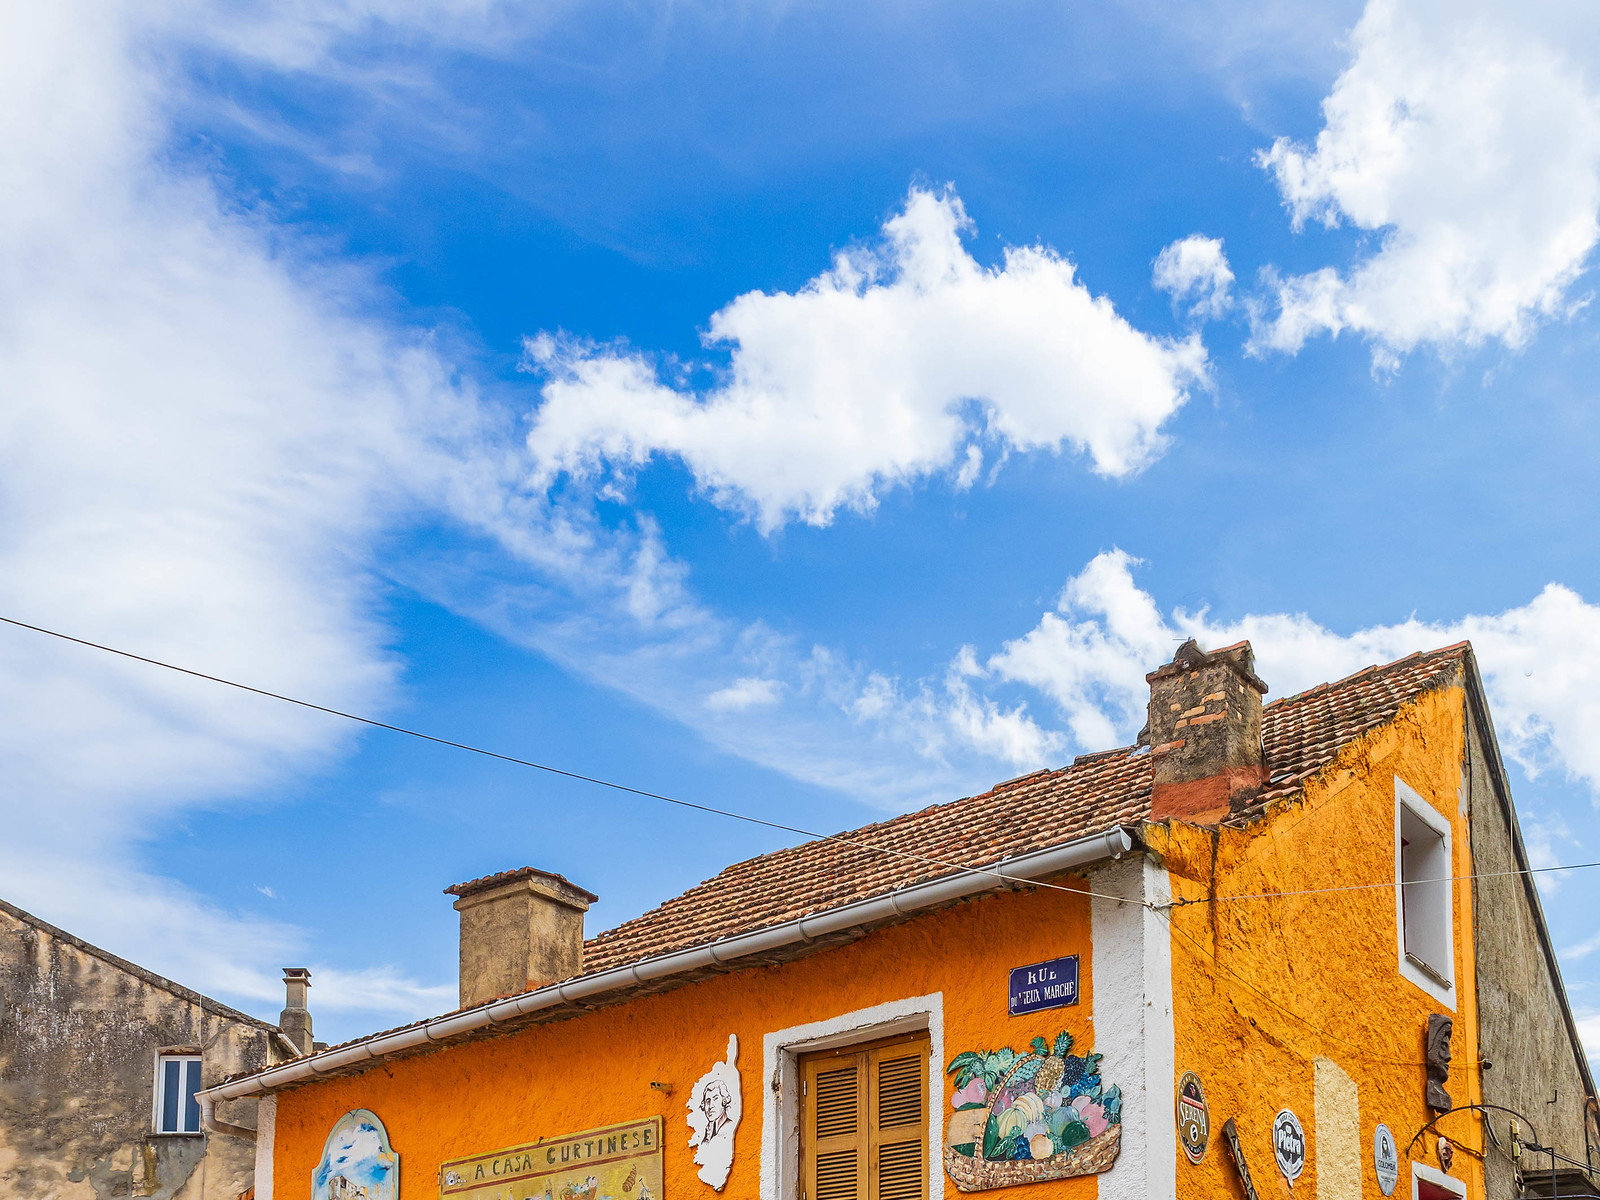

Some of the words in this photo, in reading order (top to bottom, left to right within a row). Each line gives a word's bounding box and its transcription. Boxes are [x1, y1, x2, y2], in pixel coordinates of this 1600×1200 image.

[1044, 980, 1075, 1000] MARCHÉ
[1180, 1101, 1208, 1135] SERENA
[475, 1164, 485, 1179] A
[492, 1154, 532, 1175] CASA
[546, 1129, 652, 1164] CURTINESE
[1278, 1129, 1301, 1155] Pietra
[1377, 1159, 1396, 1171] COLOMBA
